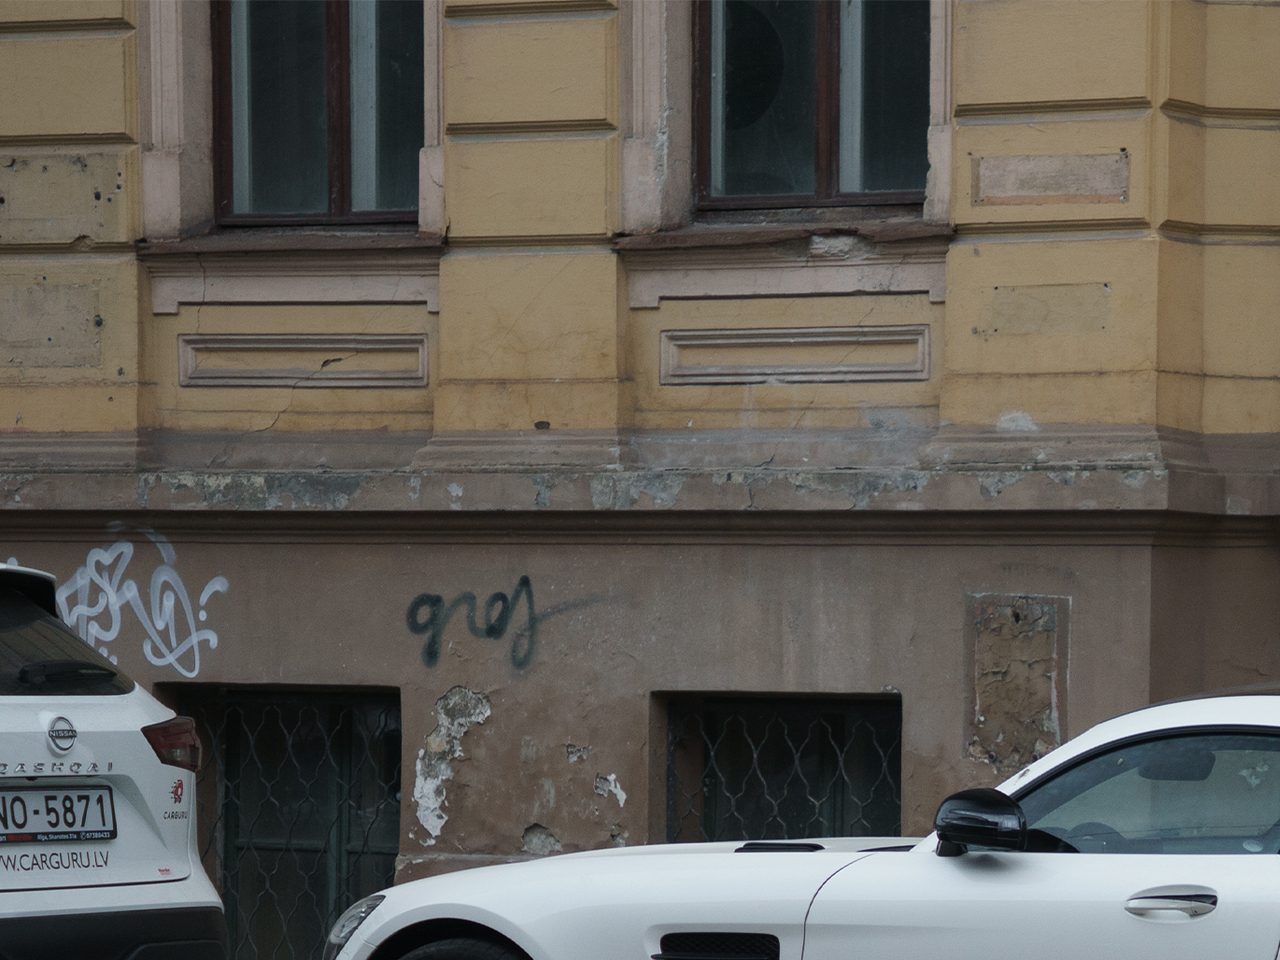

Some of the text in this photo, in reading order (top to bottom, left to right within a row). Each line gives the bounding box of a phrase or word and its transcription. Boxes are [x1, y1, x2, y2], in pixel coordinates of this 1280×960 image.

[51, 730, 77, 738] NISSAN
[0, 762, 113, 774] QASHQAI
[163, 811, 188, 820] CARGURU
[0, 851, 109, 871] W.CARGURU.LV
